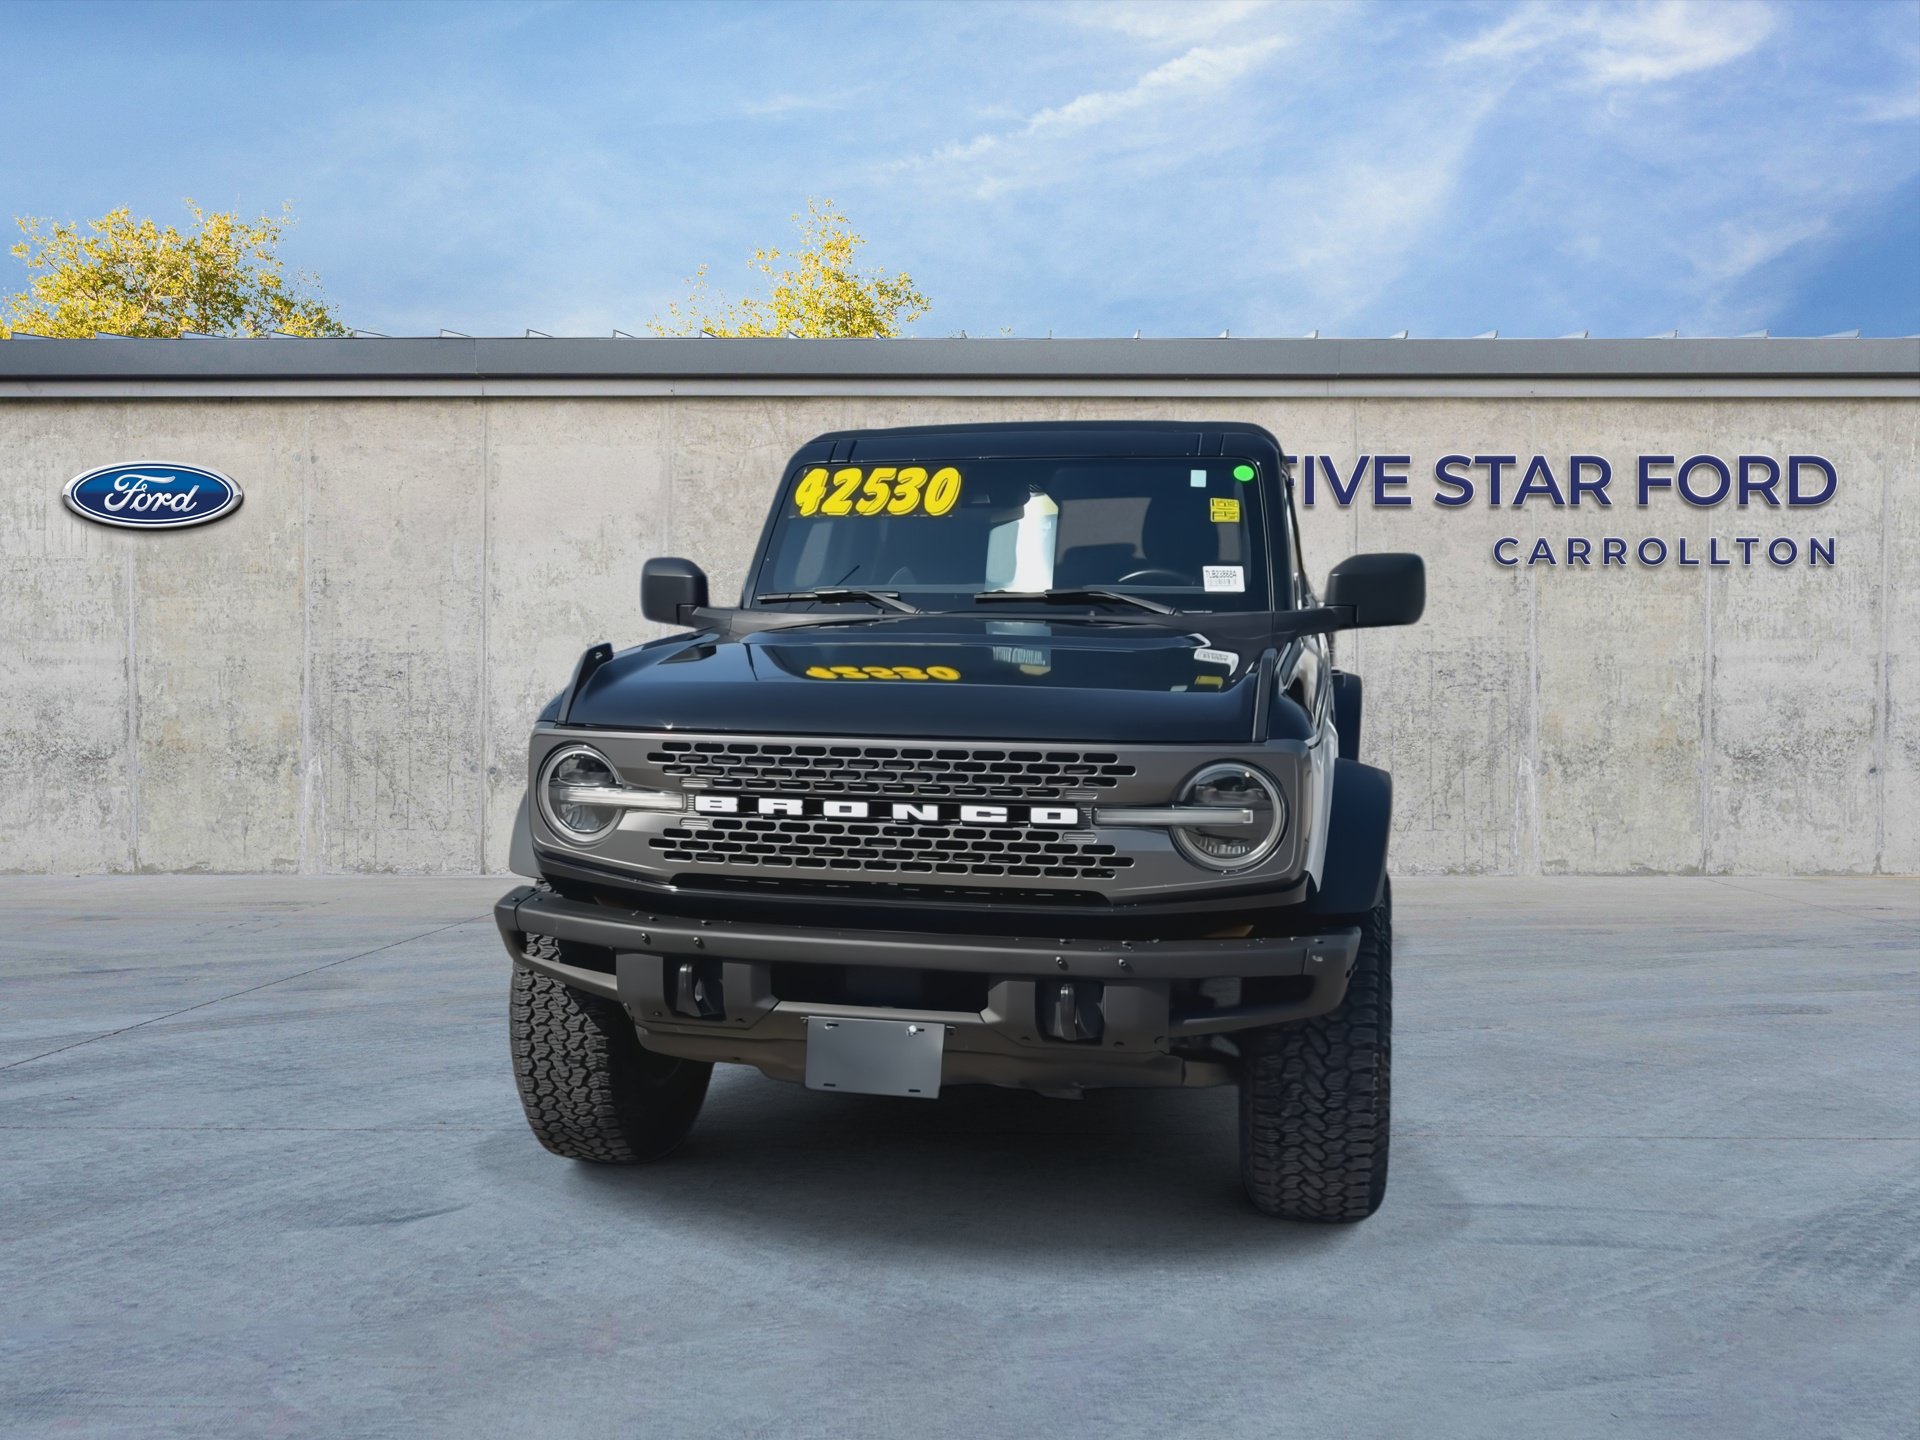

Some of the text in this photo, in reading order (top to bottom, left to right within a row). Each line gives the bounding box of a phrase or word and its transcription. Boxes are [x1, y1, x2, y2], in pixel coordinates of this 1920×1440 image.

[103, 473, 200, 512] Ford
[794, 466, 963, 517] 42530
[1433, 454, 1613, 507] STAR
[1637, 454, 1838, 507] FORD
[1493, 536, 1836, 566] CARROLLTON
[694, 794, 1079, 825] BRONCO
